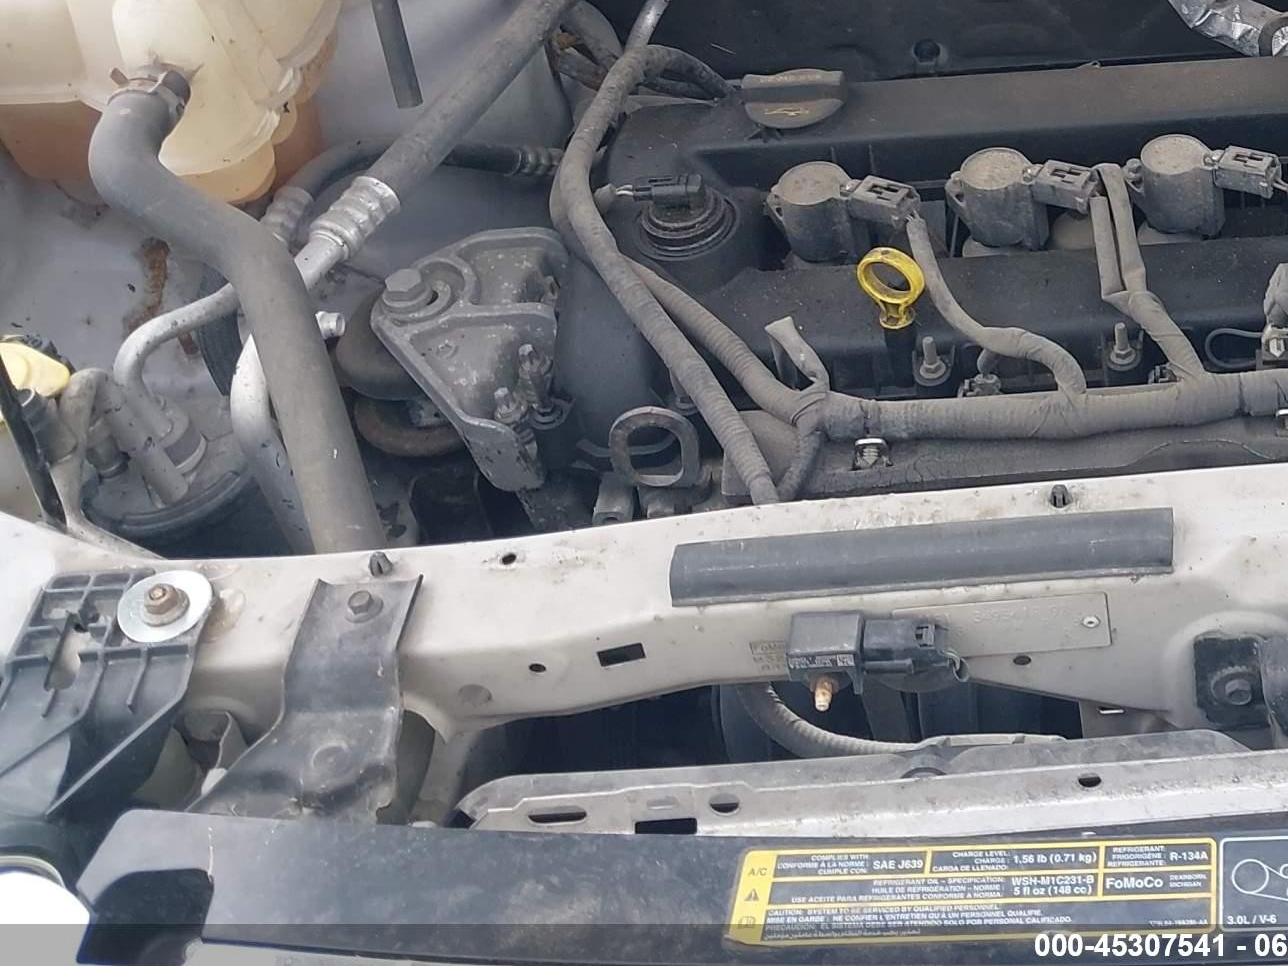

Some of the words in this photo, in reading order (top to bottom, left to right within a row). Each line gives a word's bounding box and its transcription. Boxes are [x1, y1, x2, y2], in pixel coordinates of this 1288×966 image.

[1013, 855, 1036, 864] 1.56
[1036, 854, 1048, 863] lb
[1050, 853, 1076, 864] (0.71
[1078, 852, 1097, 865] kg)
[1169, 850, 1209, 861] R-134A
[873, 860, 895, 870] SAE
[897, 859, 924, 870] J639
[748, 867, 768, 876] A/C
[1011, 874, 1095, 886] WSH-M1C231-B
[1105, 876, 1164, 890] FoMoCo
[1013, 886, 1021, 895] 5
[1022, 885, 1031, 895] fl
[1032, 886, 1046, 895] oz
[1048, 884, 1071, 896] (148
[1073, 884, 1093, 895] cc)
[1227, 915, 1250, 925] 3.0L
[1259, 914, 1277, 925] V-6
